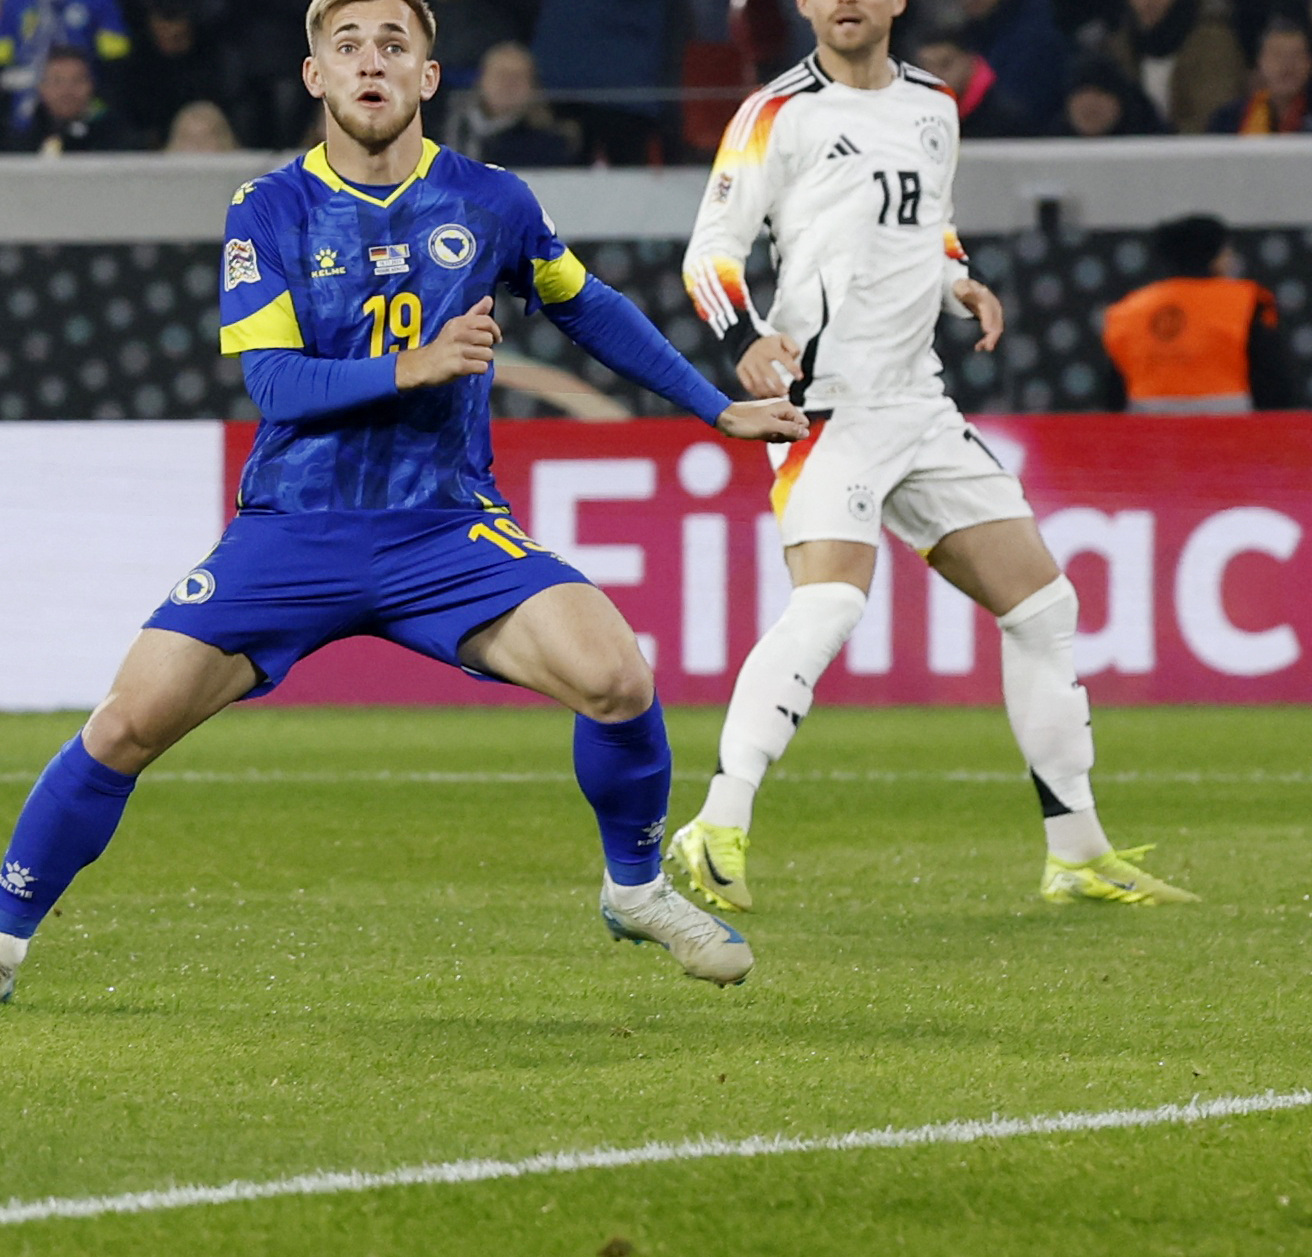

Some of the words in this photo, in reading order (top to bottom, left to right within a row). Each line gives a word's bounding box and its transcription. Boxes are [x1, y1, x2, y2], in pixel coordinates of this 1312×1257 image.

[872, 171, 921, 225] 18
[363, 292, 422, 358] 19
[468, 518, 548, 559] 19
